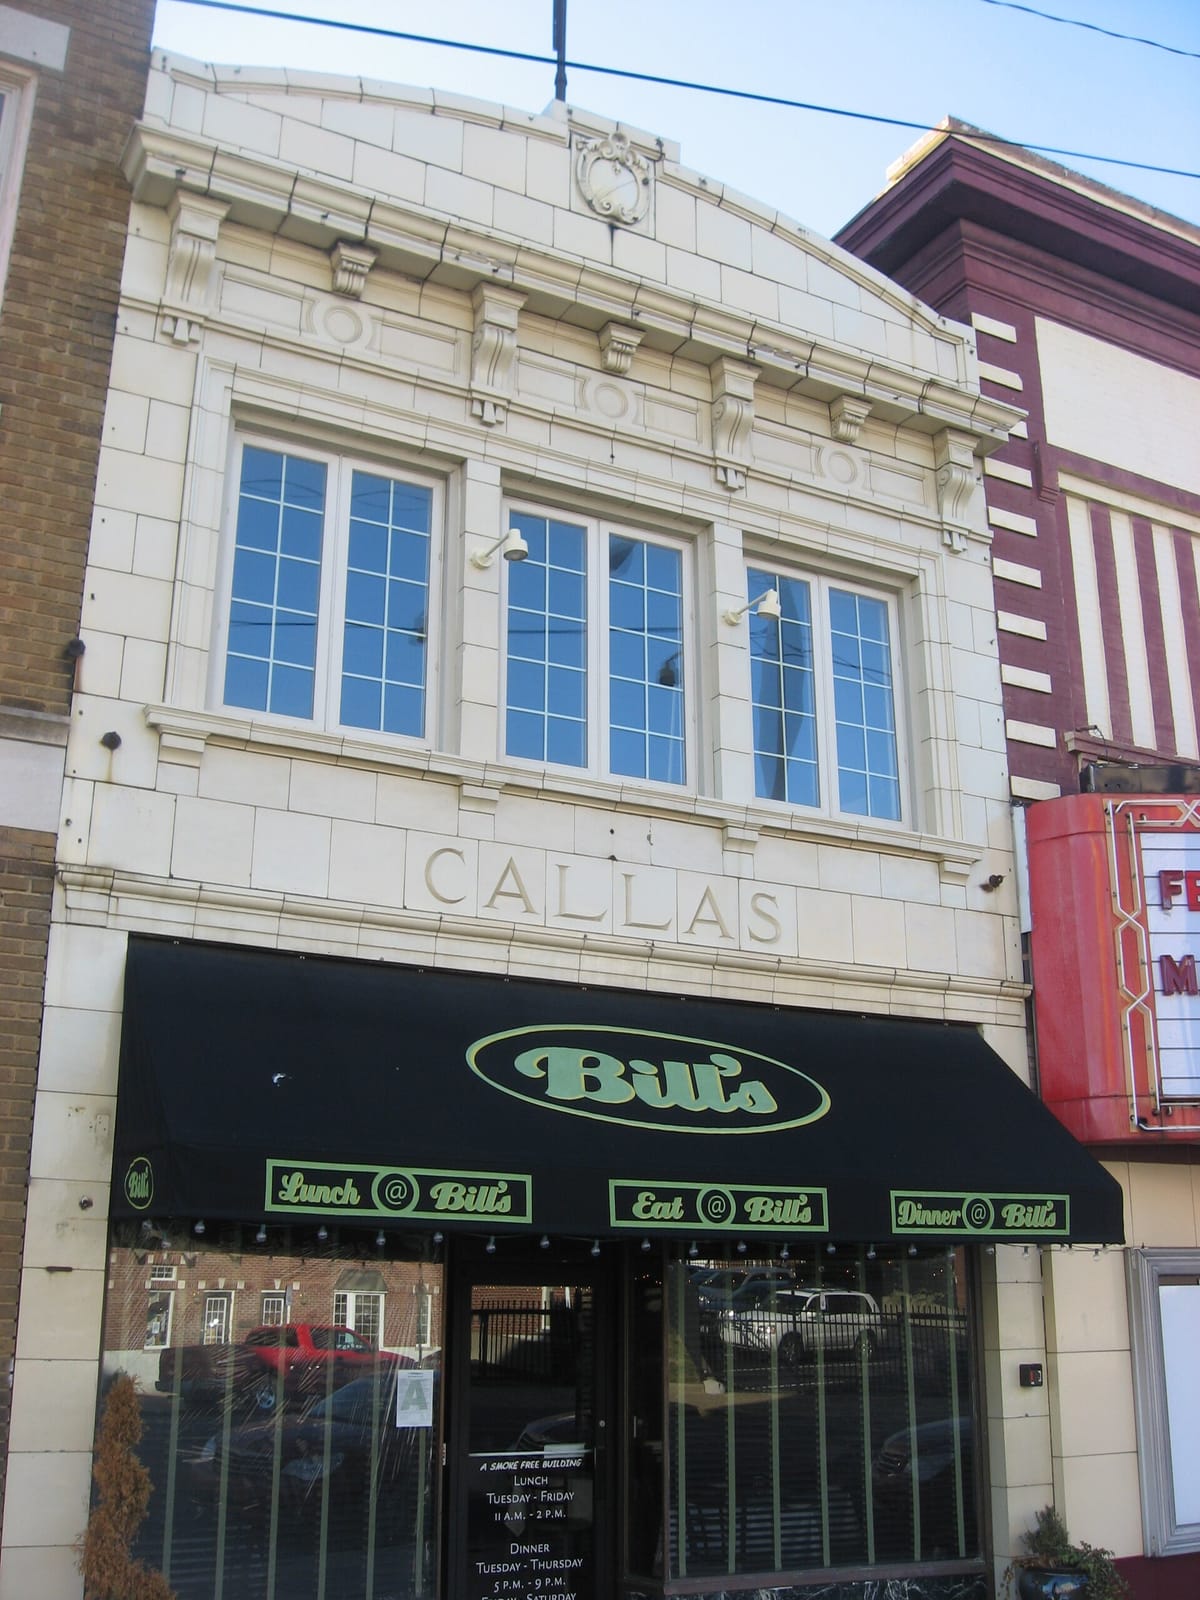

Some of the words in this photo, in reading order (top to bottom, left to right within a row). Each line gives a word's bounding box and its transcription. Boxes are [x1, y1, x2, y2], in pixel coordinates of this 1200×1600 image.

[424, 847, 782, 945] CALLAS
[513, 1046, 778, 1114] Bill's
[278, 1172, 360, 1206] Lunch
[384, 1179, 409, 1206] @
[429, 1181, 512, 1214] Bill's
[631, 1191, 684, 1219] Eat
[706, 1194, 727, 1219] @
[743, 1194, 812, 1224] Bill's
[897, 1199, 962, 1226] Dinner
[970, 1200, 989, 1224] @
[1001, 1200, 1057, 1228] Bill's
[400, 1380, 428, 1411] A
[480, 1462, 487, 1471] A
[490, 1461, 518, 1471] SMOKE
[521, 1460, 539, 1469] FREE
[542, 1458, 582, 1468] BUILDING
[514, 1475, 548, 1486] LUNCH
[486, 1492, 531, 1504] TUESDAY
[540, 1490, 575, 1501] FRIDAY
[504, 1511, 526, 1520] A.M.
[536, 1510, 542, 1519] 2
[545, 1509, 566, 1518] P.M.
[510, 1543, 550, 1554] DINNER
[475, 1562, 521, 1574] TUESDAY
[530, 1558, 583, 1570] THURSDAY
[493, 1581, 500, 1593] 5
[503, 1580, 524, 1589] P.M.
[535, 1578, 542, 1589] 9
[545, 1577, 566, 1586] P.M.
